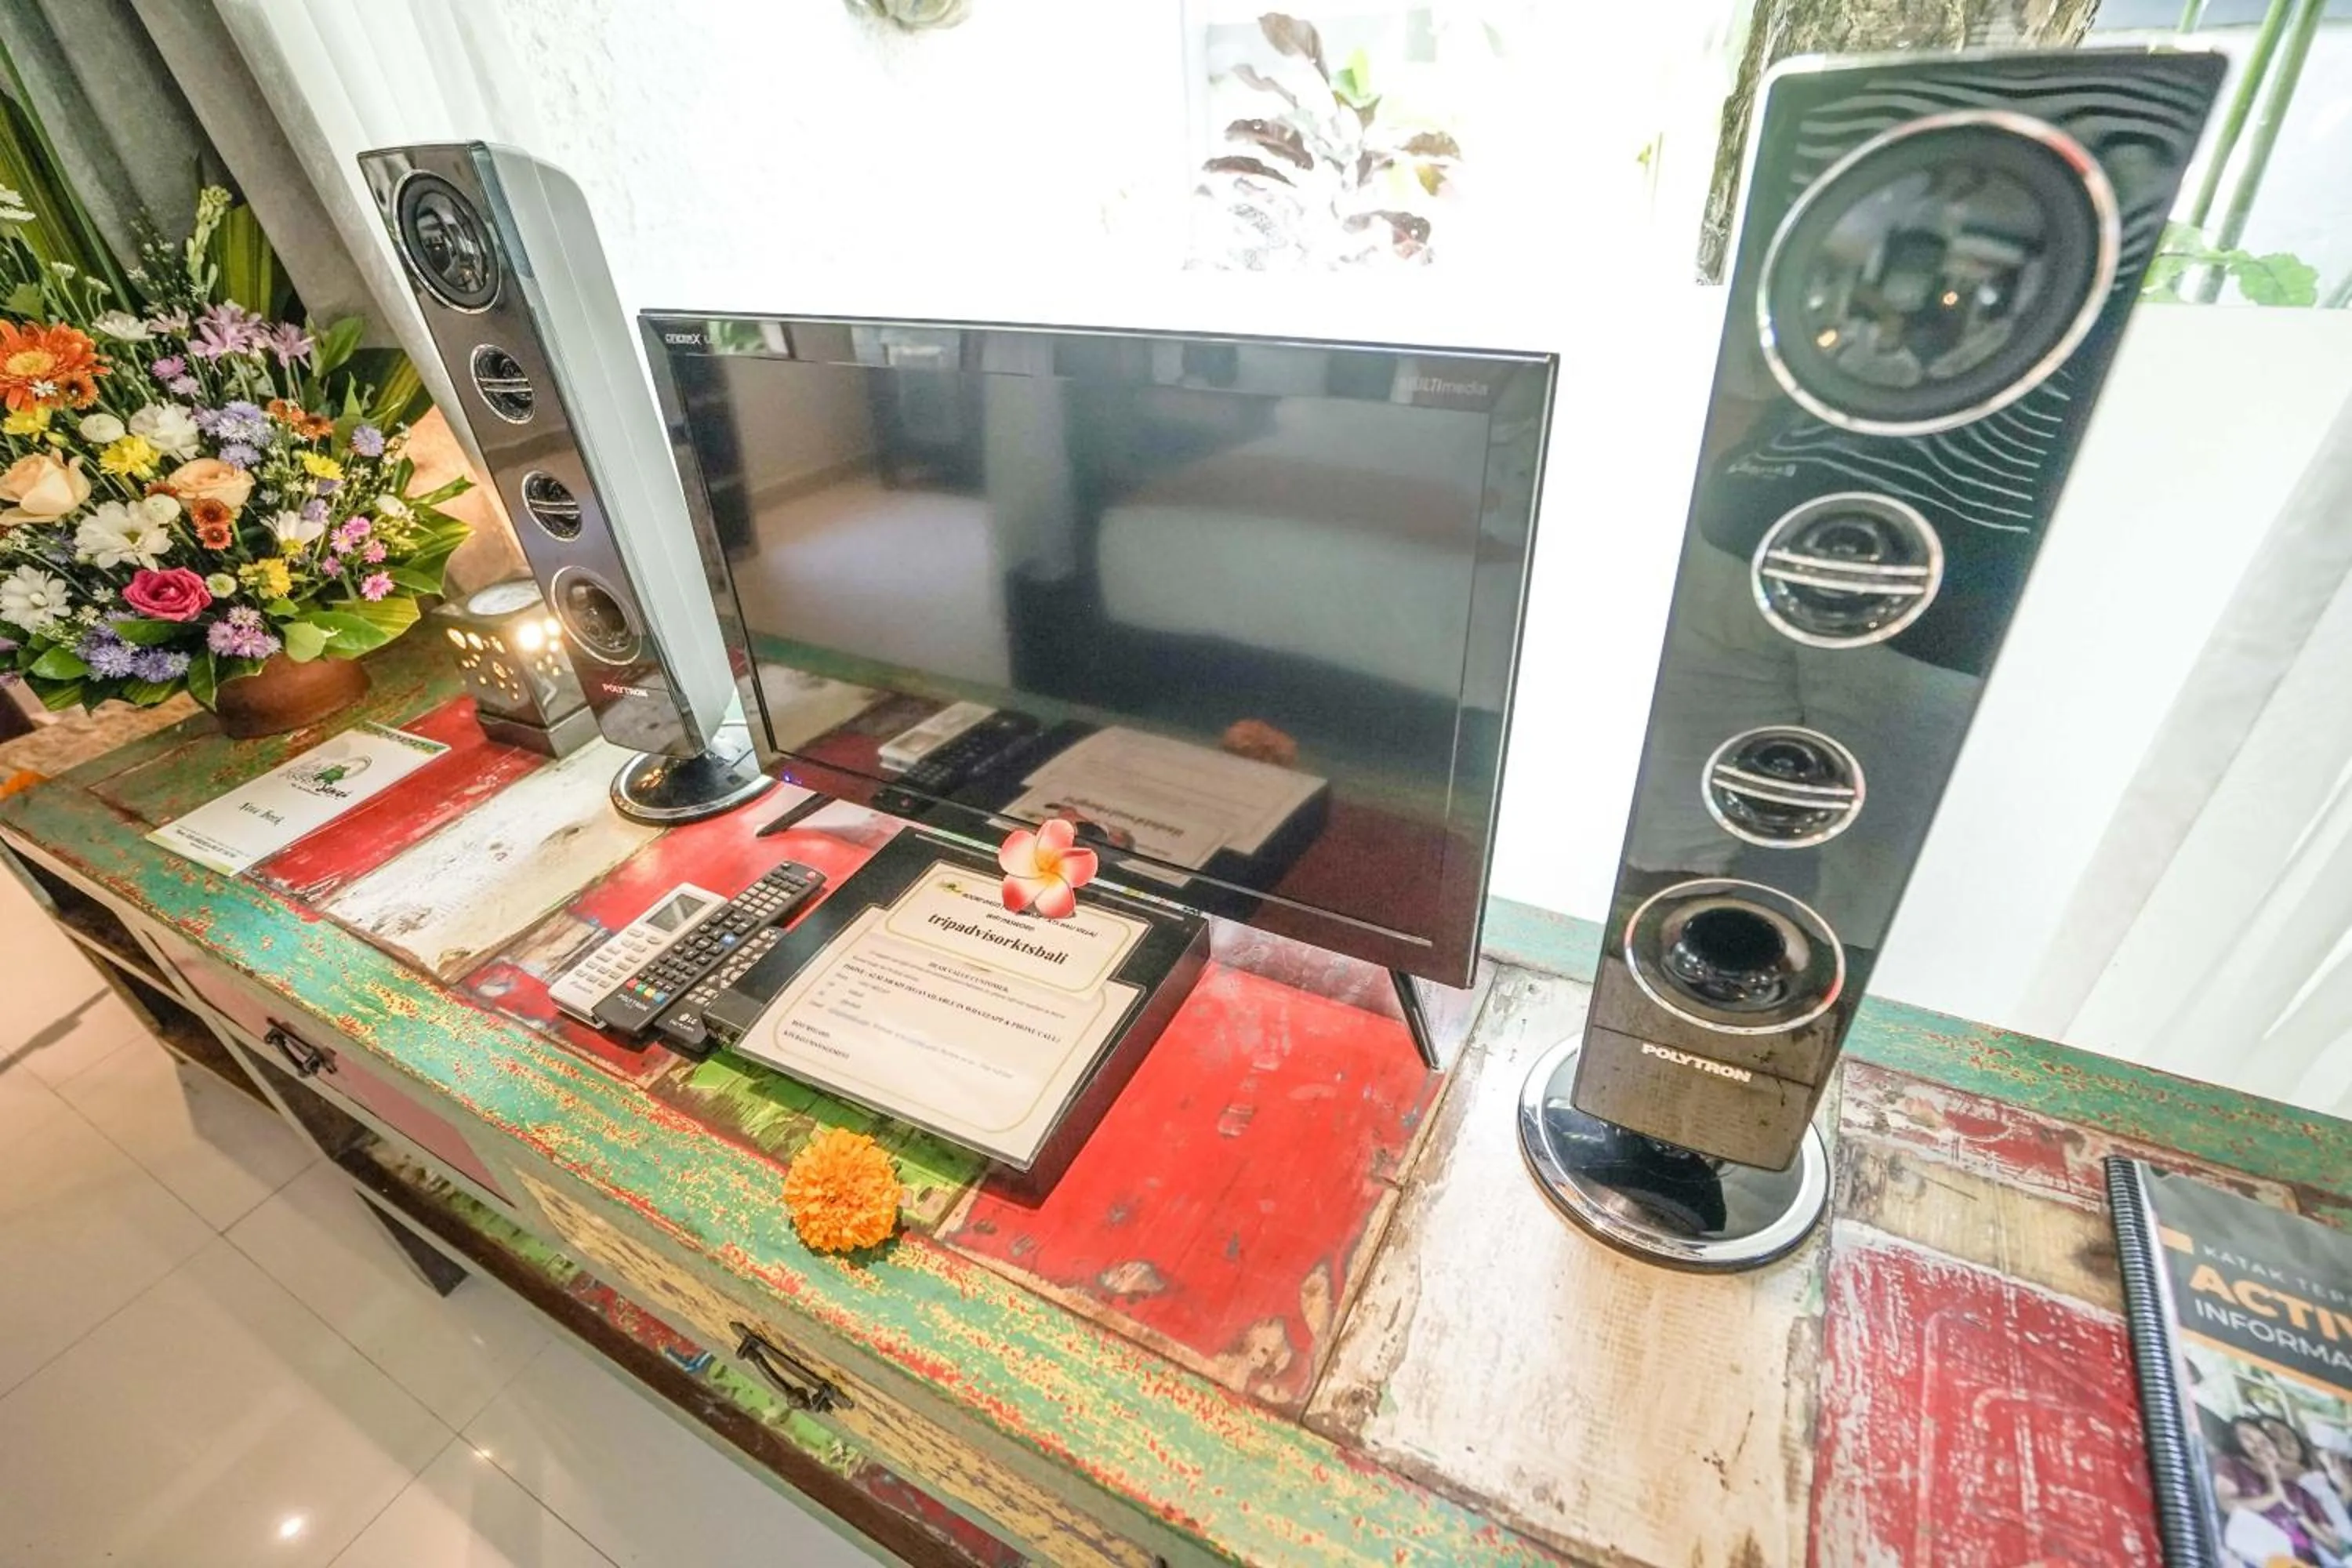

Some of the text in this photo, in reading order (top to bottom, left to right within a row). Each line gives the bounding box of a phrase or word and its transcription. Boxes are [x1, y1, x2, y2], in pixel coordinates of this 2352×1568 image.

[601, 683, 649, 698] POLYTRON
[928, 913, 1069, 966] tripadvisorktsbali
[1641, 1043, 1752, 1083] POLYTRON
[2202, 1244, 2352, 1308] KATAK TEP
[2195, 1298, 2352, 1371] INFORMA
